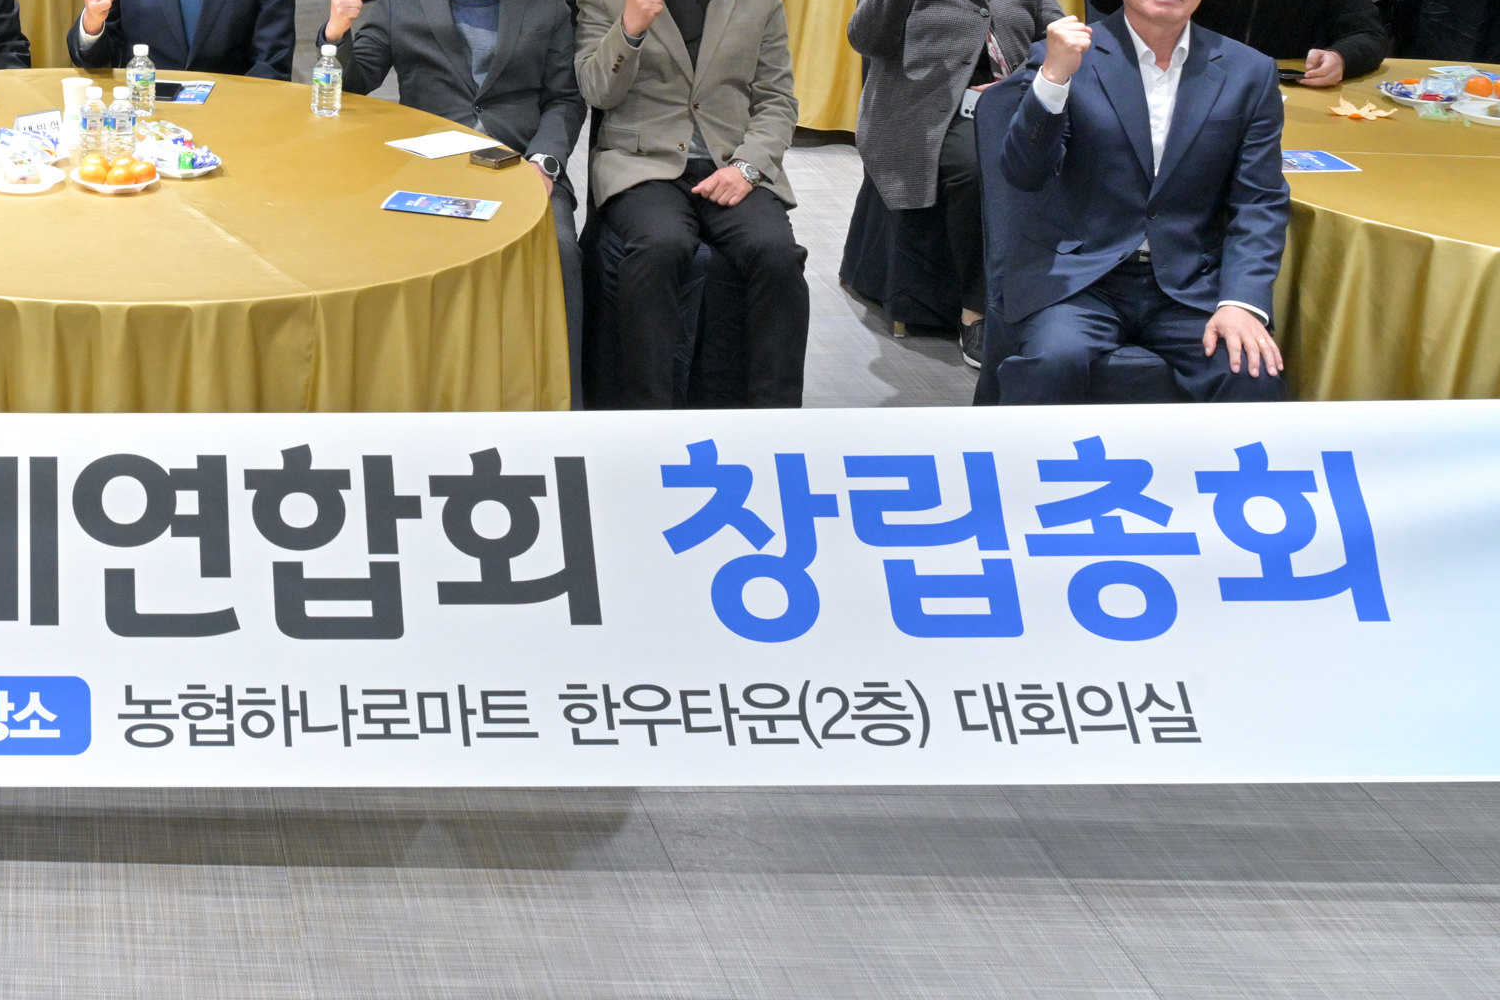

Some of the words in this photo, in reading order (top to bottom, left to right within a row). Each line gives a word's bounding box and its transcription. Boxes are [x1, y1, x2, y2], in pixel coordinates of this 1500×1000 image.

[661, 436, 1390, 643] 창립총회
[118, 685, 538, 747] 농협하나로마트
[559, 680, 930, 748] 한우타운(2층)
[954, 682, 1201, 744] 대회의실
